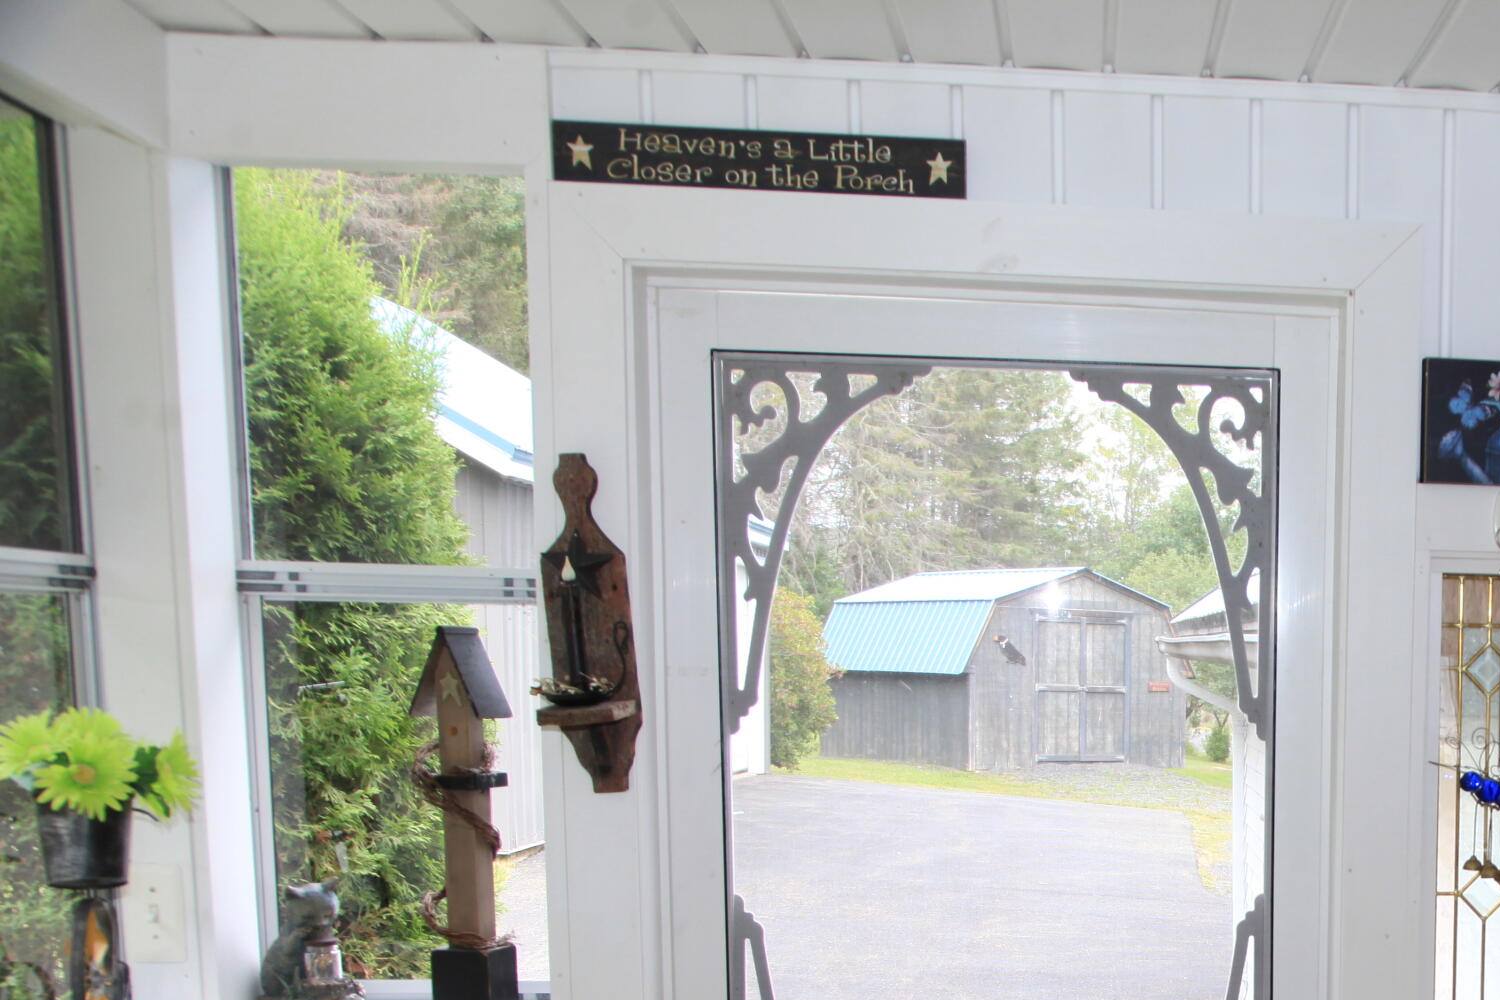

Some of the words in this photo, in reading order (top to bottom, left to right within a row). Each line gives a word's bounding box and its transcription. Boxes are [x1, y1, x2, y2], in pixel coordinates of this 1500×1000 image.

[619, 127, 761, 159] Heaven's
[774, 140, 794, 158] a
[808, 138, 892, 163] Little
[607, 155, 712, 183] Closer
[725, 169, 758, 187] on
[765, 162, 819, 189] the
[834, 165, 914, 194] Porch
